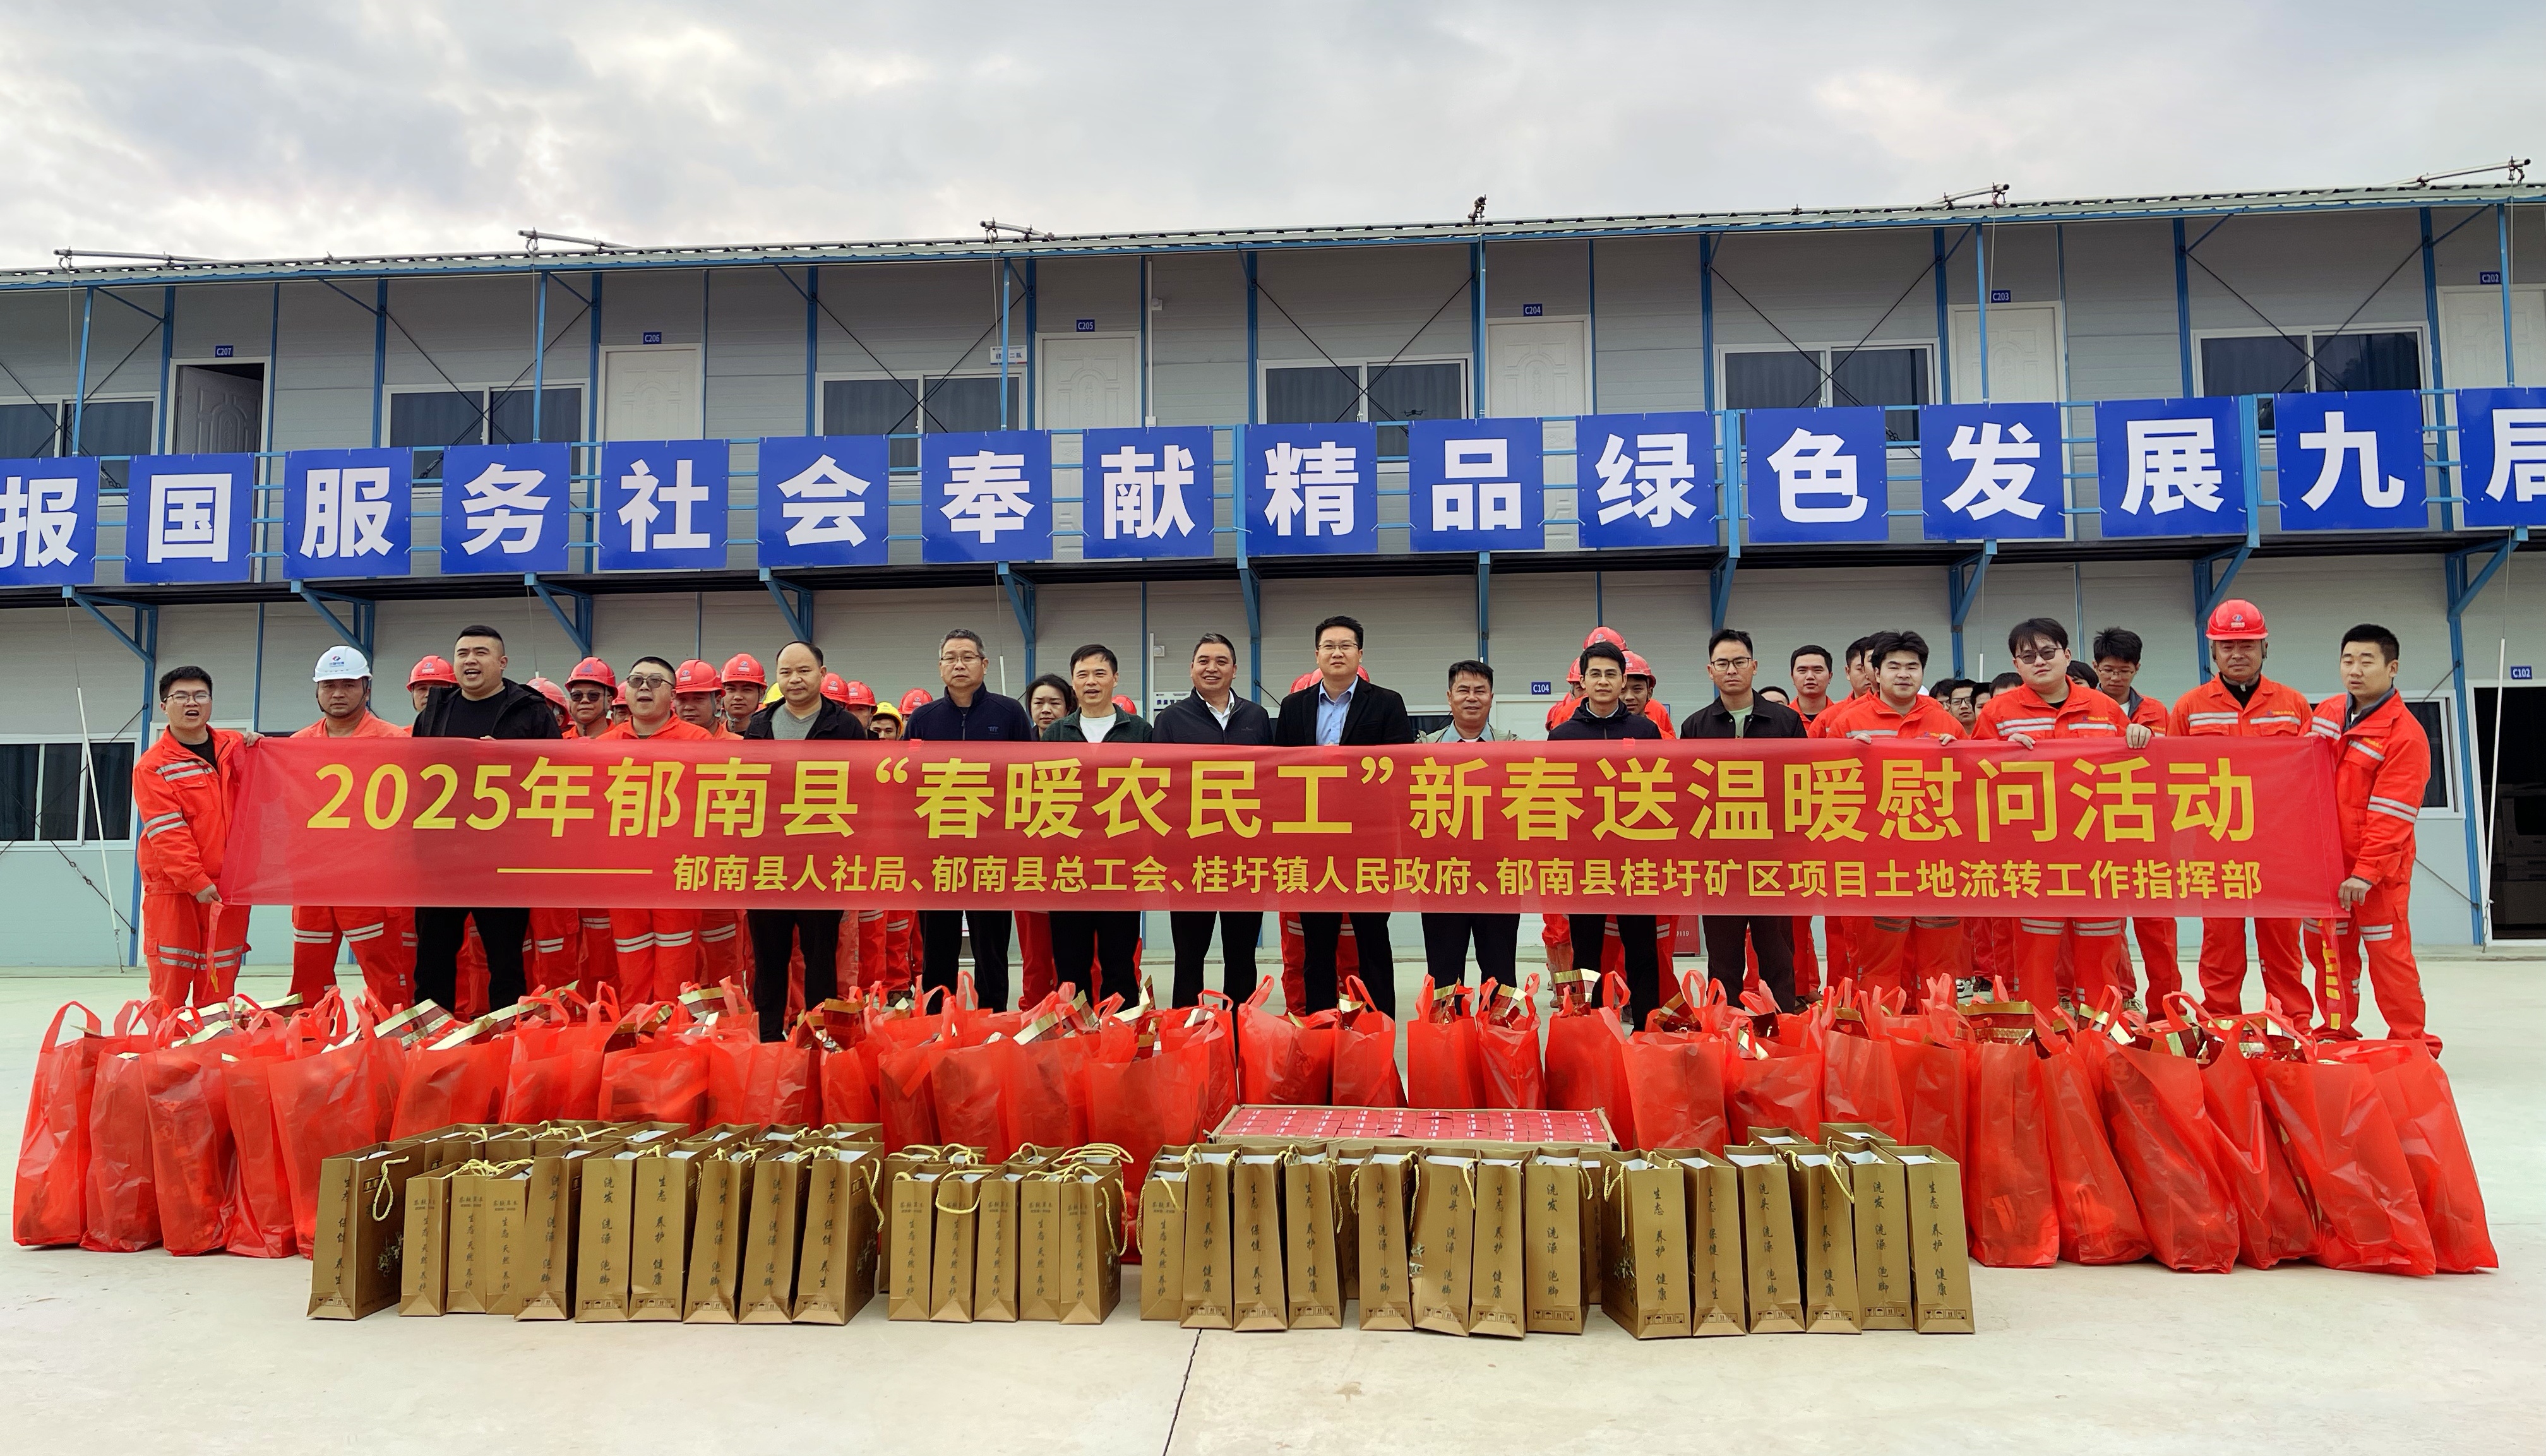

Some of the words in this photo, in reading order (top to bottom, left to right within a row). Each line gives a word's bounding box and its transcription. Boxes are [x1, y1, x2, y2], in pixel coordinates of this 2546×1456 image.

[2482, 273, 2499, 283] C202
[1992, 292, 2009, 301] C203
[1525, 306, 1541, 314] C204
[1077, 321, 1094, 330] C205
[217, 347, 232, 355] C207
[2513, 668, 2530, 678] C102
[1533, 684, 1550, 693] C104
